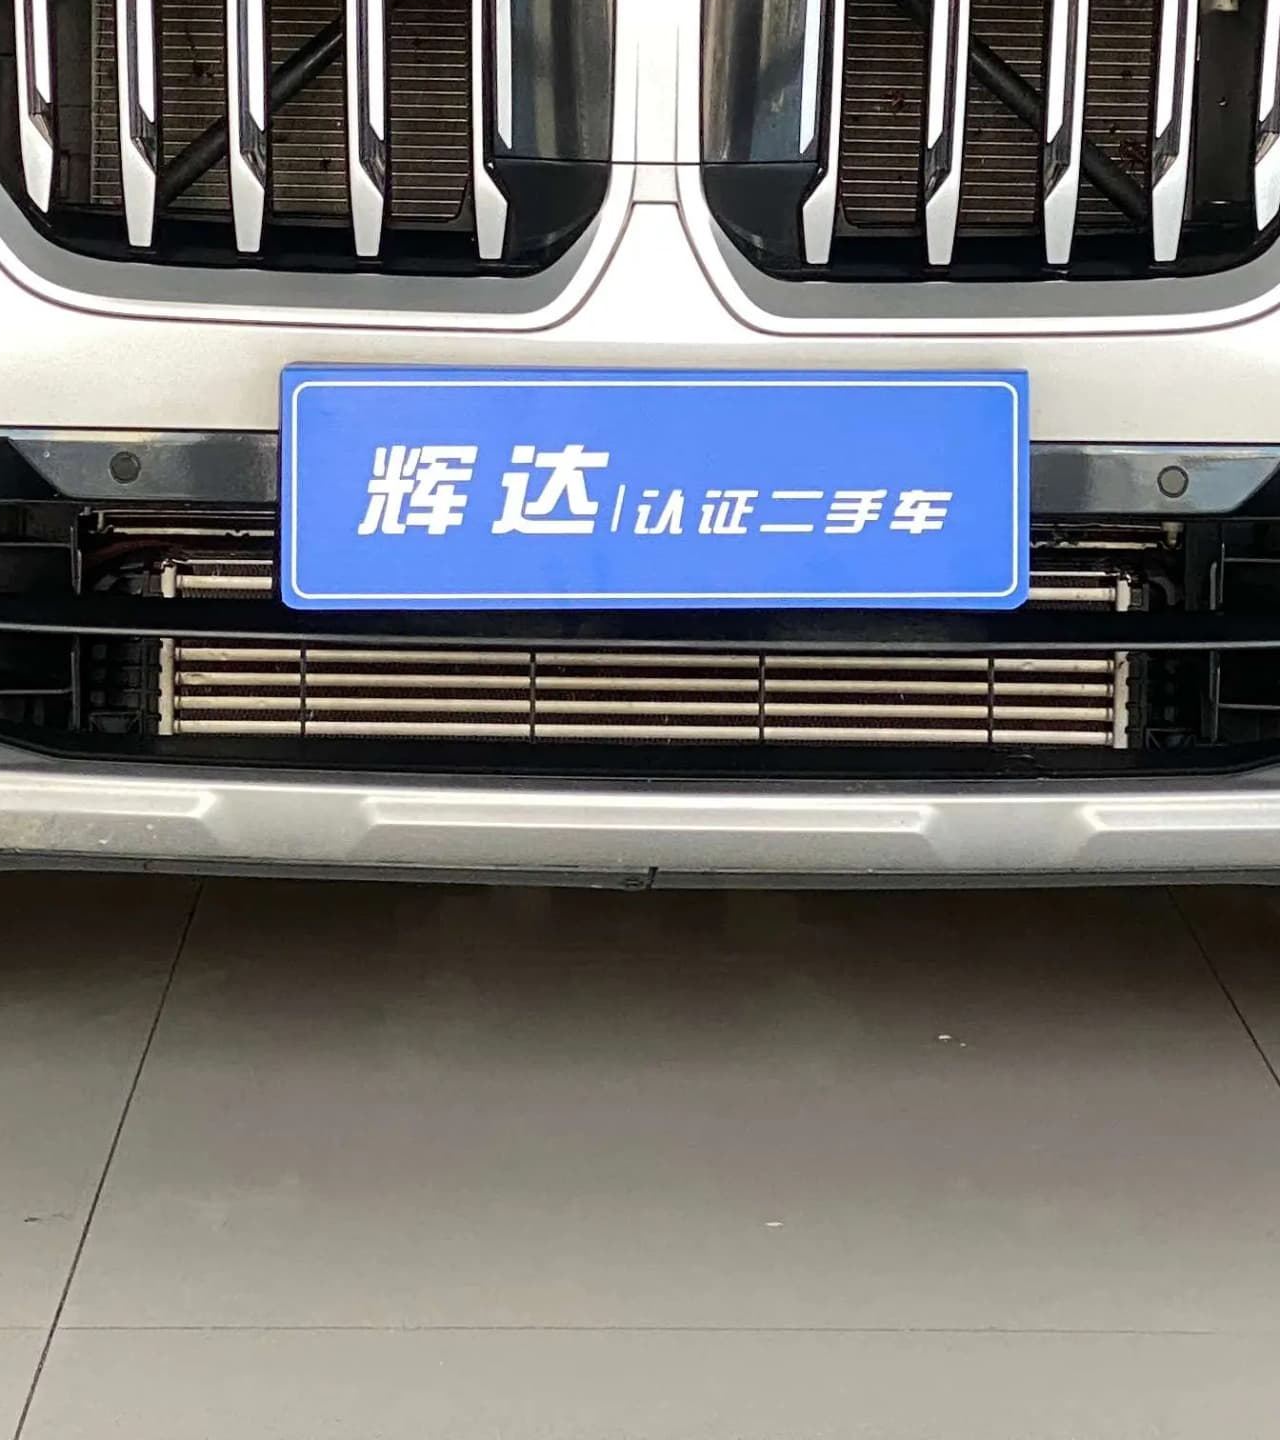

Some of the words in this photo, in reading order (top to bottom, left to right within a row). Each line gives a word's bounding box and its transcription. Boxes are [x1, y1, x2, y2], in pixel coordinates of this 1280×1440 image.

[358, 444, 610, 535] 辉达
[633, 489, 953, 535] 认证二手车
